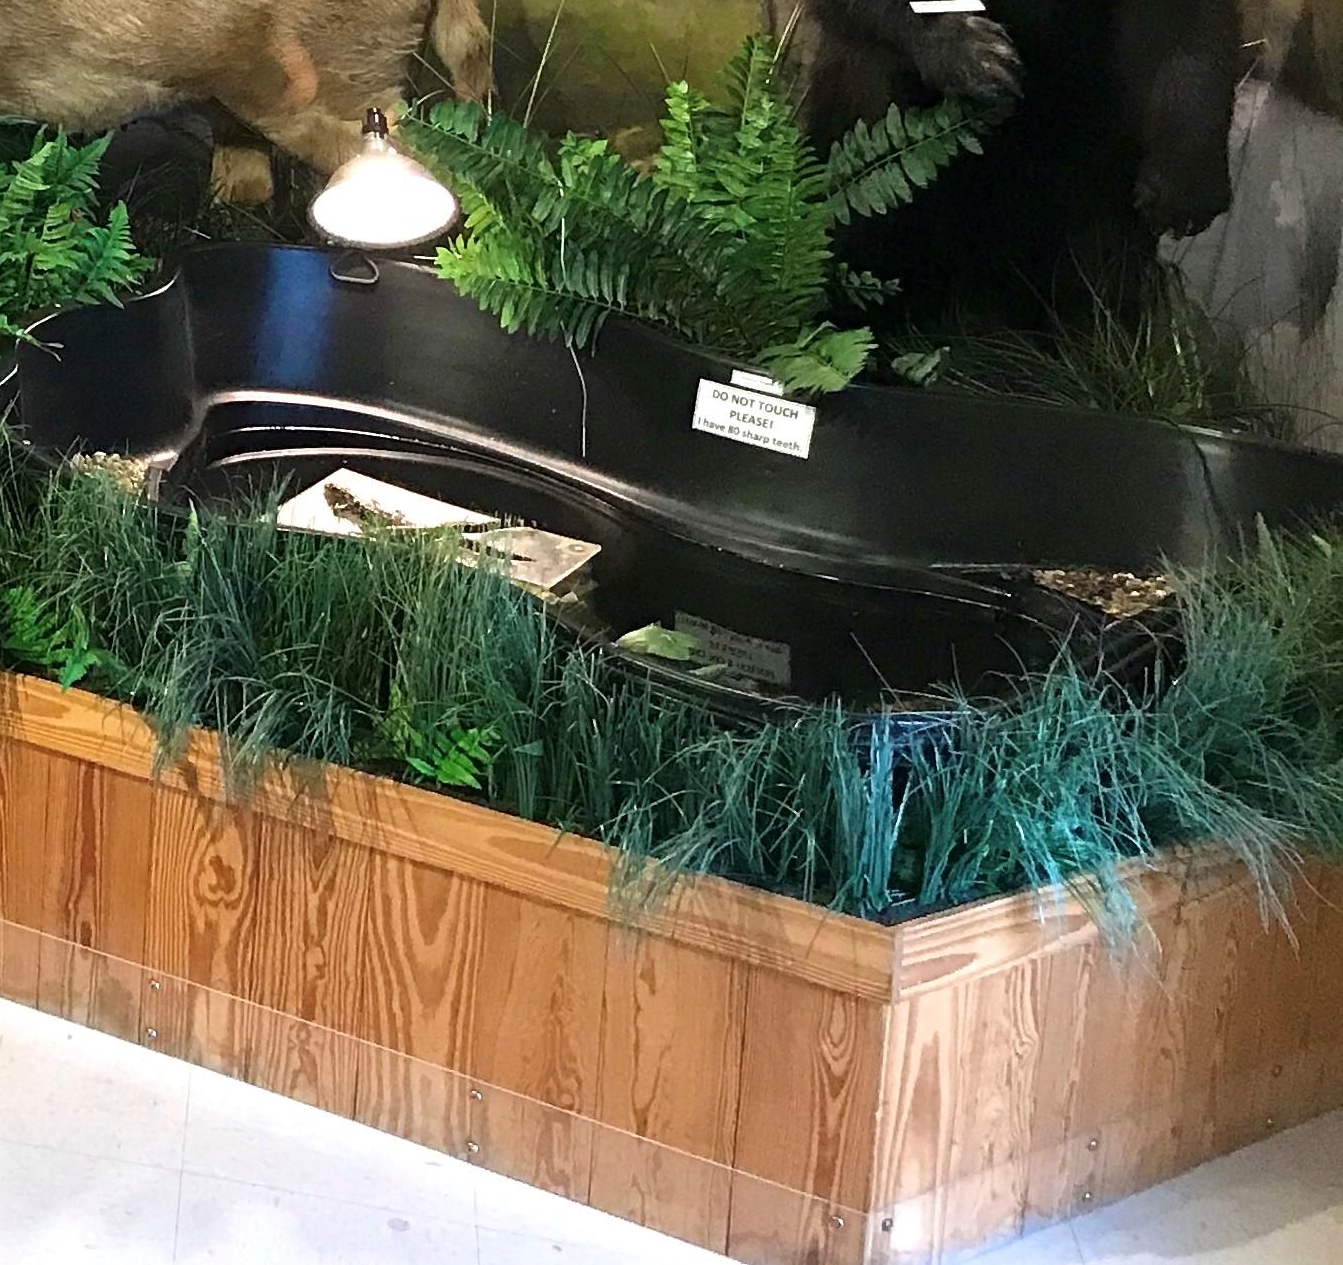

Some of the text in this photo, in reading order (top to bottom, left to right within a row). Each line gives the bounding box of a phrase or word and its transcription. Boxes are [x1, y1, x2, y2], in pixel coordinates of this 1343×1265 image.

[712, 389, 799, 420] DO NOT TOUCH
[729, 410, 775, 429] PLEASE!
[703, 417, 726, 432] have
[727, 425, 740, 436] 80
[742, 429, 770, 445] sharp
[772, 437, 803, 453] teeth.
